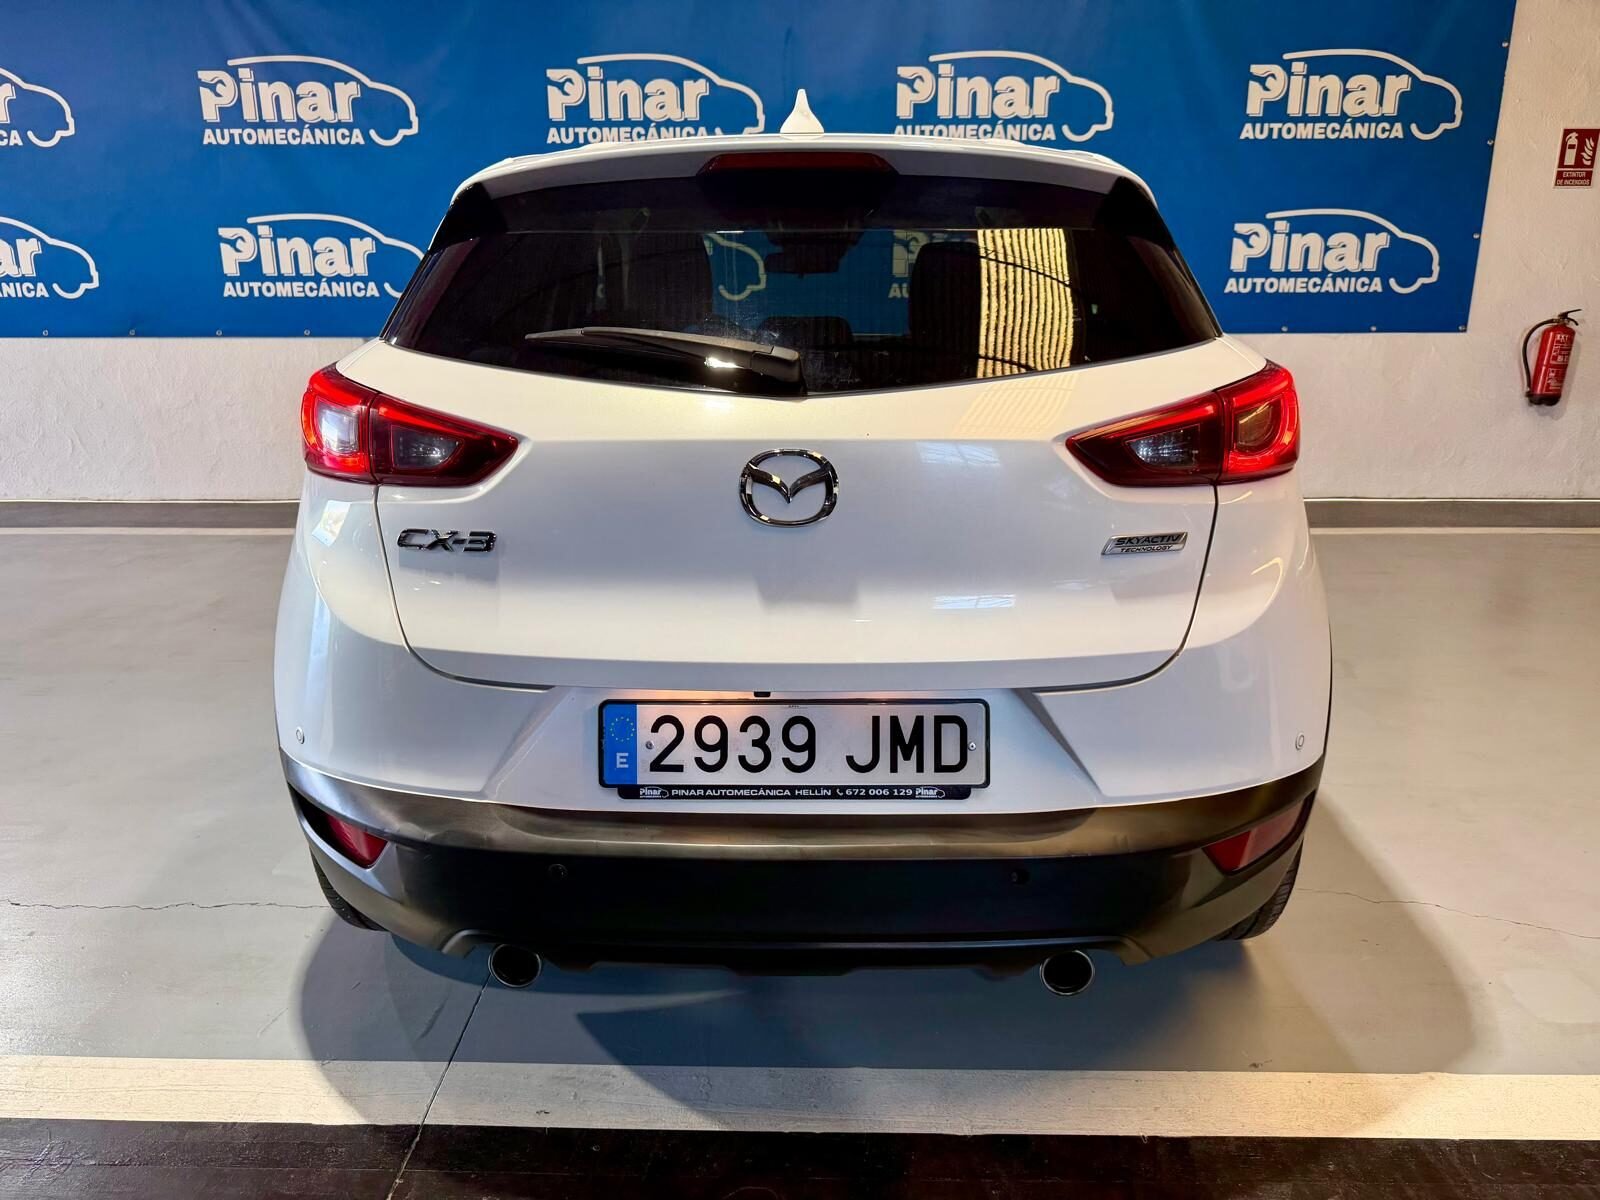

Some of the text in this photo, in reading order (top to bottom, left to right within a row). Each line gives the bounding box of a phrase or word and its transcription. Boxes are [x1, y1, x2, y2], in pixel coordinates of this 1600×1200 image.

[197, 67, 362, 123] Pinar
[546, 66, 709, 122] Pinar
[896, 63, 1060, 119] Pinar
[1245, 61, 1412, 117] Pinar
[203, 124, 365, 146] AUTOMECÁNICA
[894, 120, 1057, 141] AUTOMECÁNICA
[1239, 118, 1404, 140] AUTOMECÁNICA
[218, 225, 376, 277] Pinar
[1230, 220, 1390, 273] Pinar
[223, 277, 380, 298] AUTOMECÁNICA
[1224, 274, 1382, 295] AUTOMECÁNICA
[397, 528, 498, 552] CX-3
[1115, 534, 1182, 546] SKYACTIV
[1120, 545, 1173, 553] TECHNOLOGY
[649, 714, 816, 773] 2939
[845, 715, 968, 773] JMD
[616, 752, 629, 768] E
[705, 787, 791, 796] AUTOMECÁNICA
[845, 788, 866, 796] 672
[869, 788, 889, 796] 006
[893, 788, 913, 796] 129
